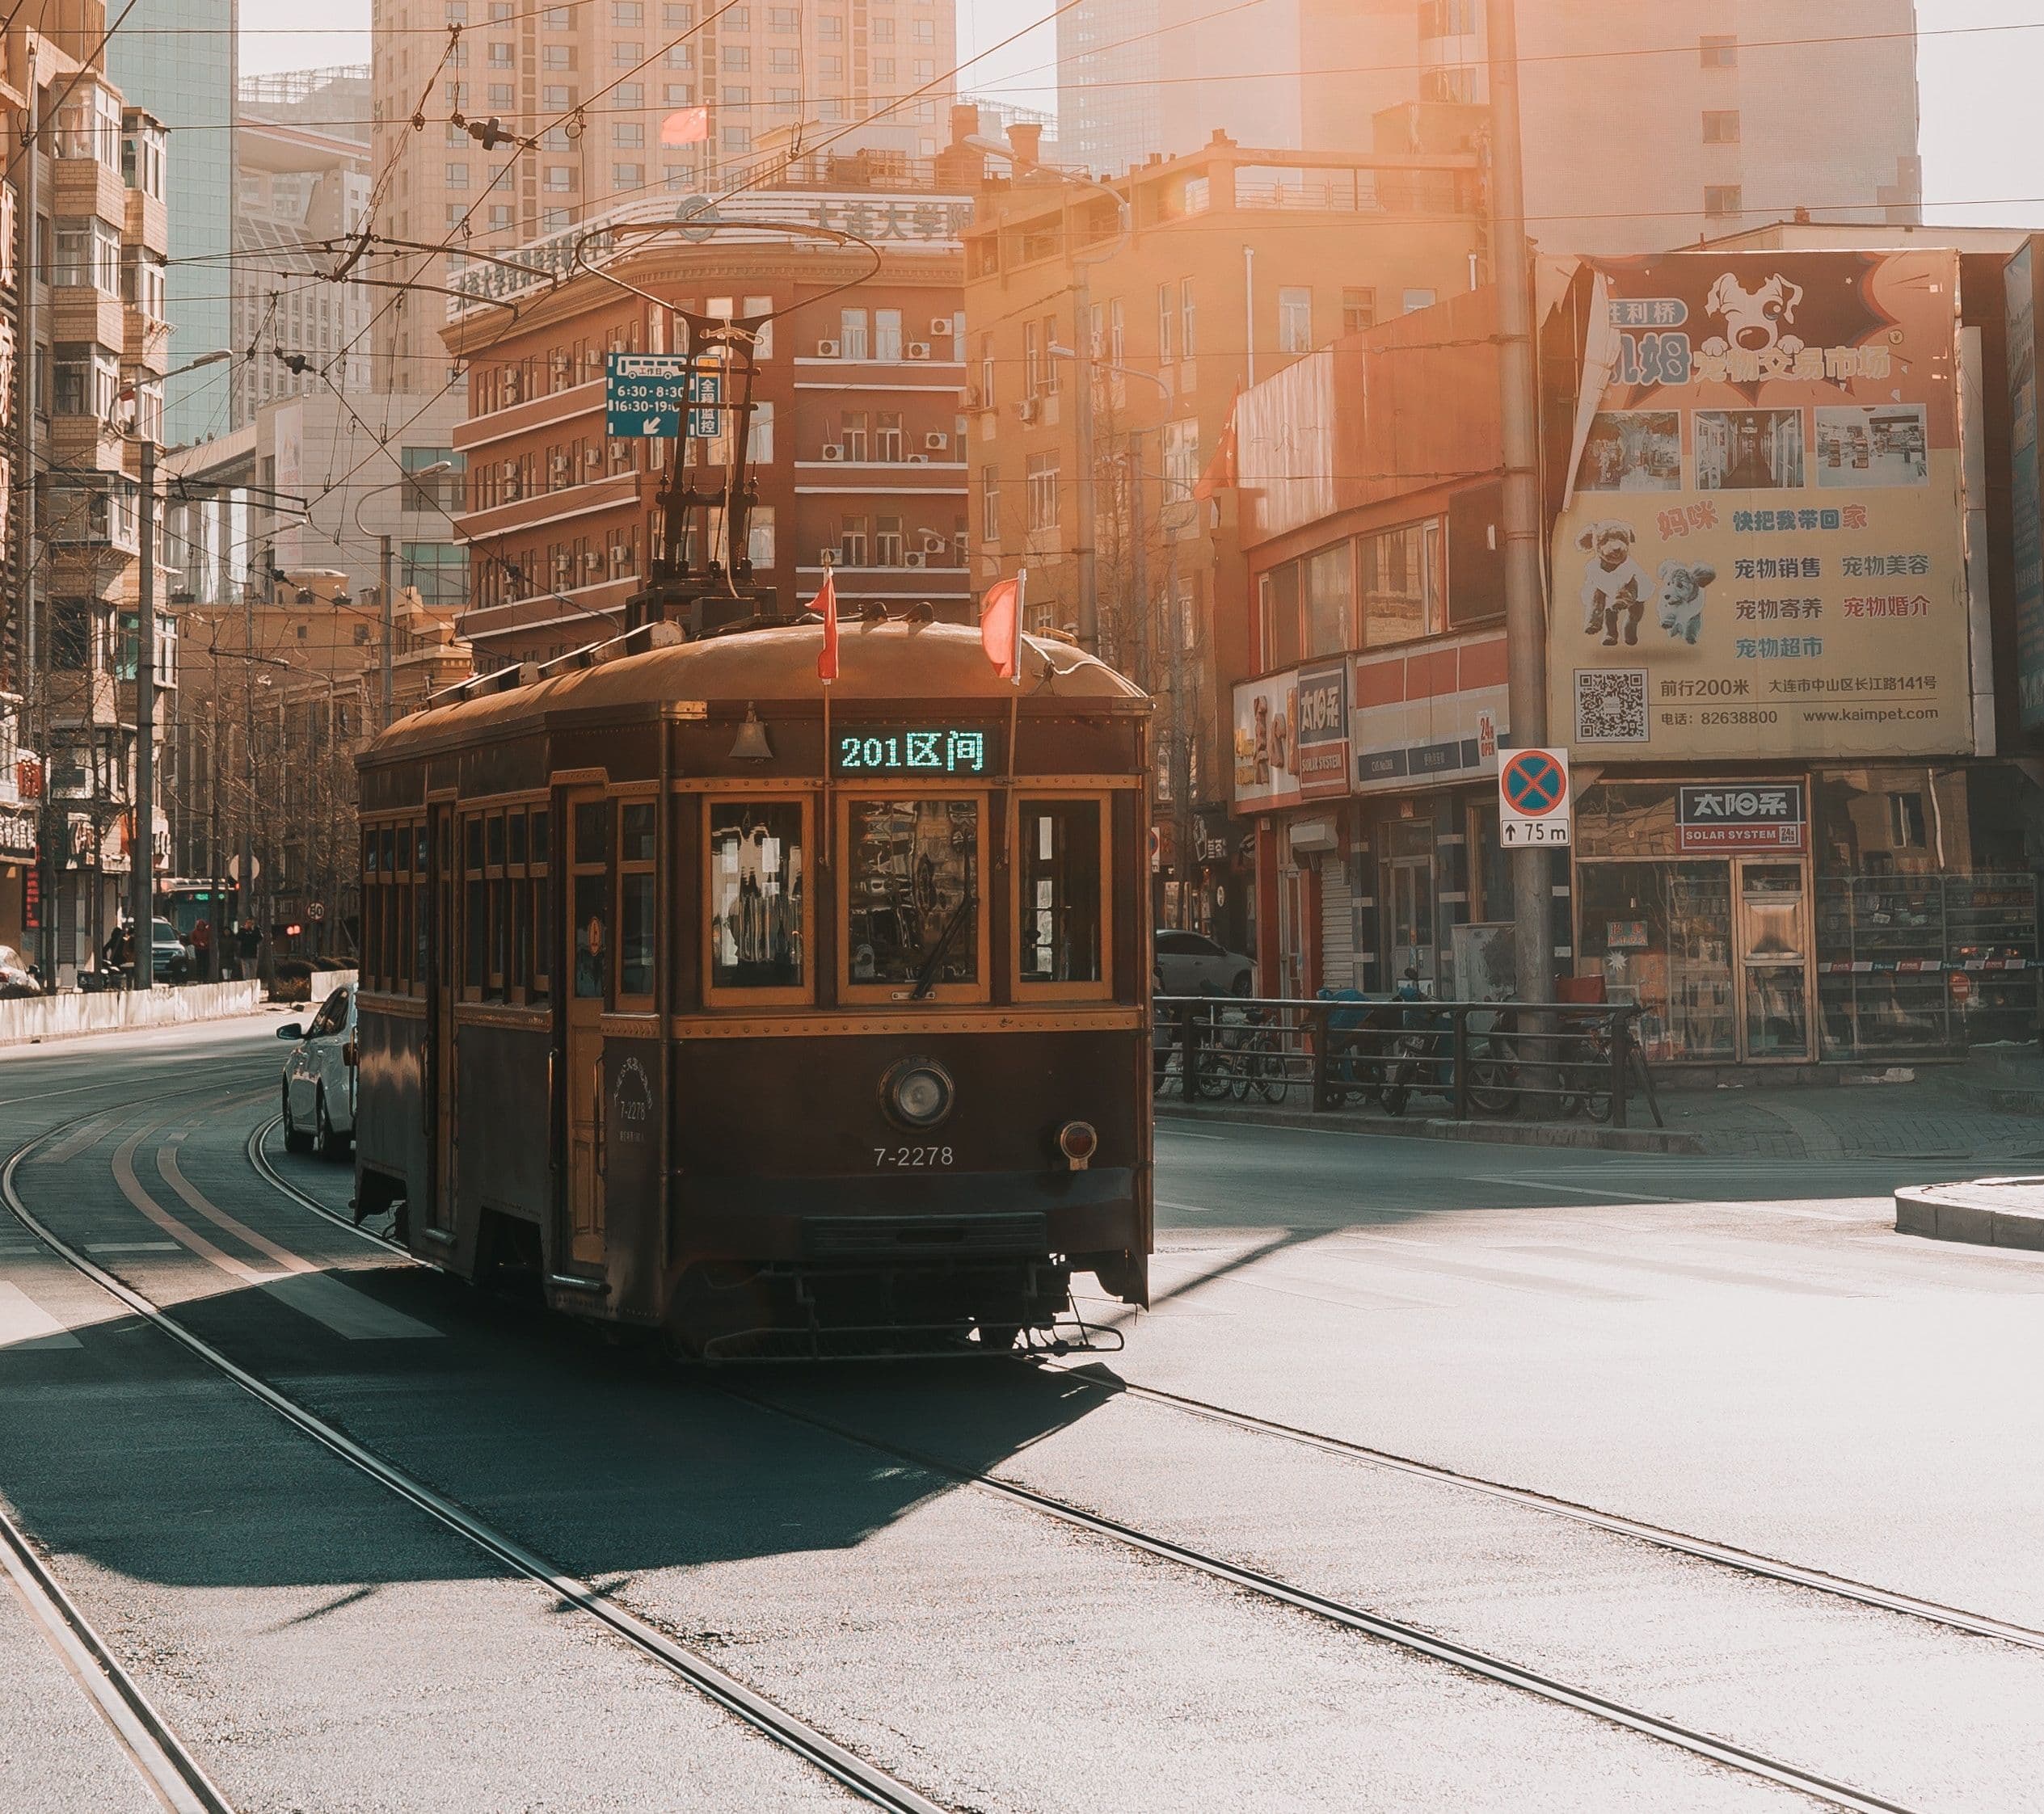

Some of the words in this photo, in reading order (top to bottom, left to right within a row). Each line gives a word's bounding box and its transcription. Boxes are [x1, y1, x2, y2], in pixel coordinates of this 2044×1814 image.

[1693, 346, 1891, 383] 宠物交易市场
[1656, 500, 1719, 541] 妈咪
[1733, 504, 1869, 533] 快把我带回家
[1734, 556, 1821, 579] 宠物销售
[1842, 553, 1930, 576] 宠物美容
[1735, 598, 1823, 621] 宠物寄养
[1844, 595, 1931, 618] 宠物婚介
[1735, 637, 1823, 659] 宠物超市
[1660, 679, 1750, 697] 前行200米
[1768, 676, 1937, 694] 大连市中山区长江路141号
[1701, 710, 1778, 726] 82638800
[1803, 707, 1939, 723] www.kaimpet.com
[841, 730, 983, 771] 201区间
[1693, 792, 1788, 817] 太阳系
[1524, 823, 1545, 841] 75
[1550, 828, 1566, 841] m
[1686, 831, 1725, 840] SOLAR
[1728, 830, 1776, 840] SYSTEM
[874, 1147, 954, 1166] 7-2278
